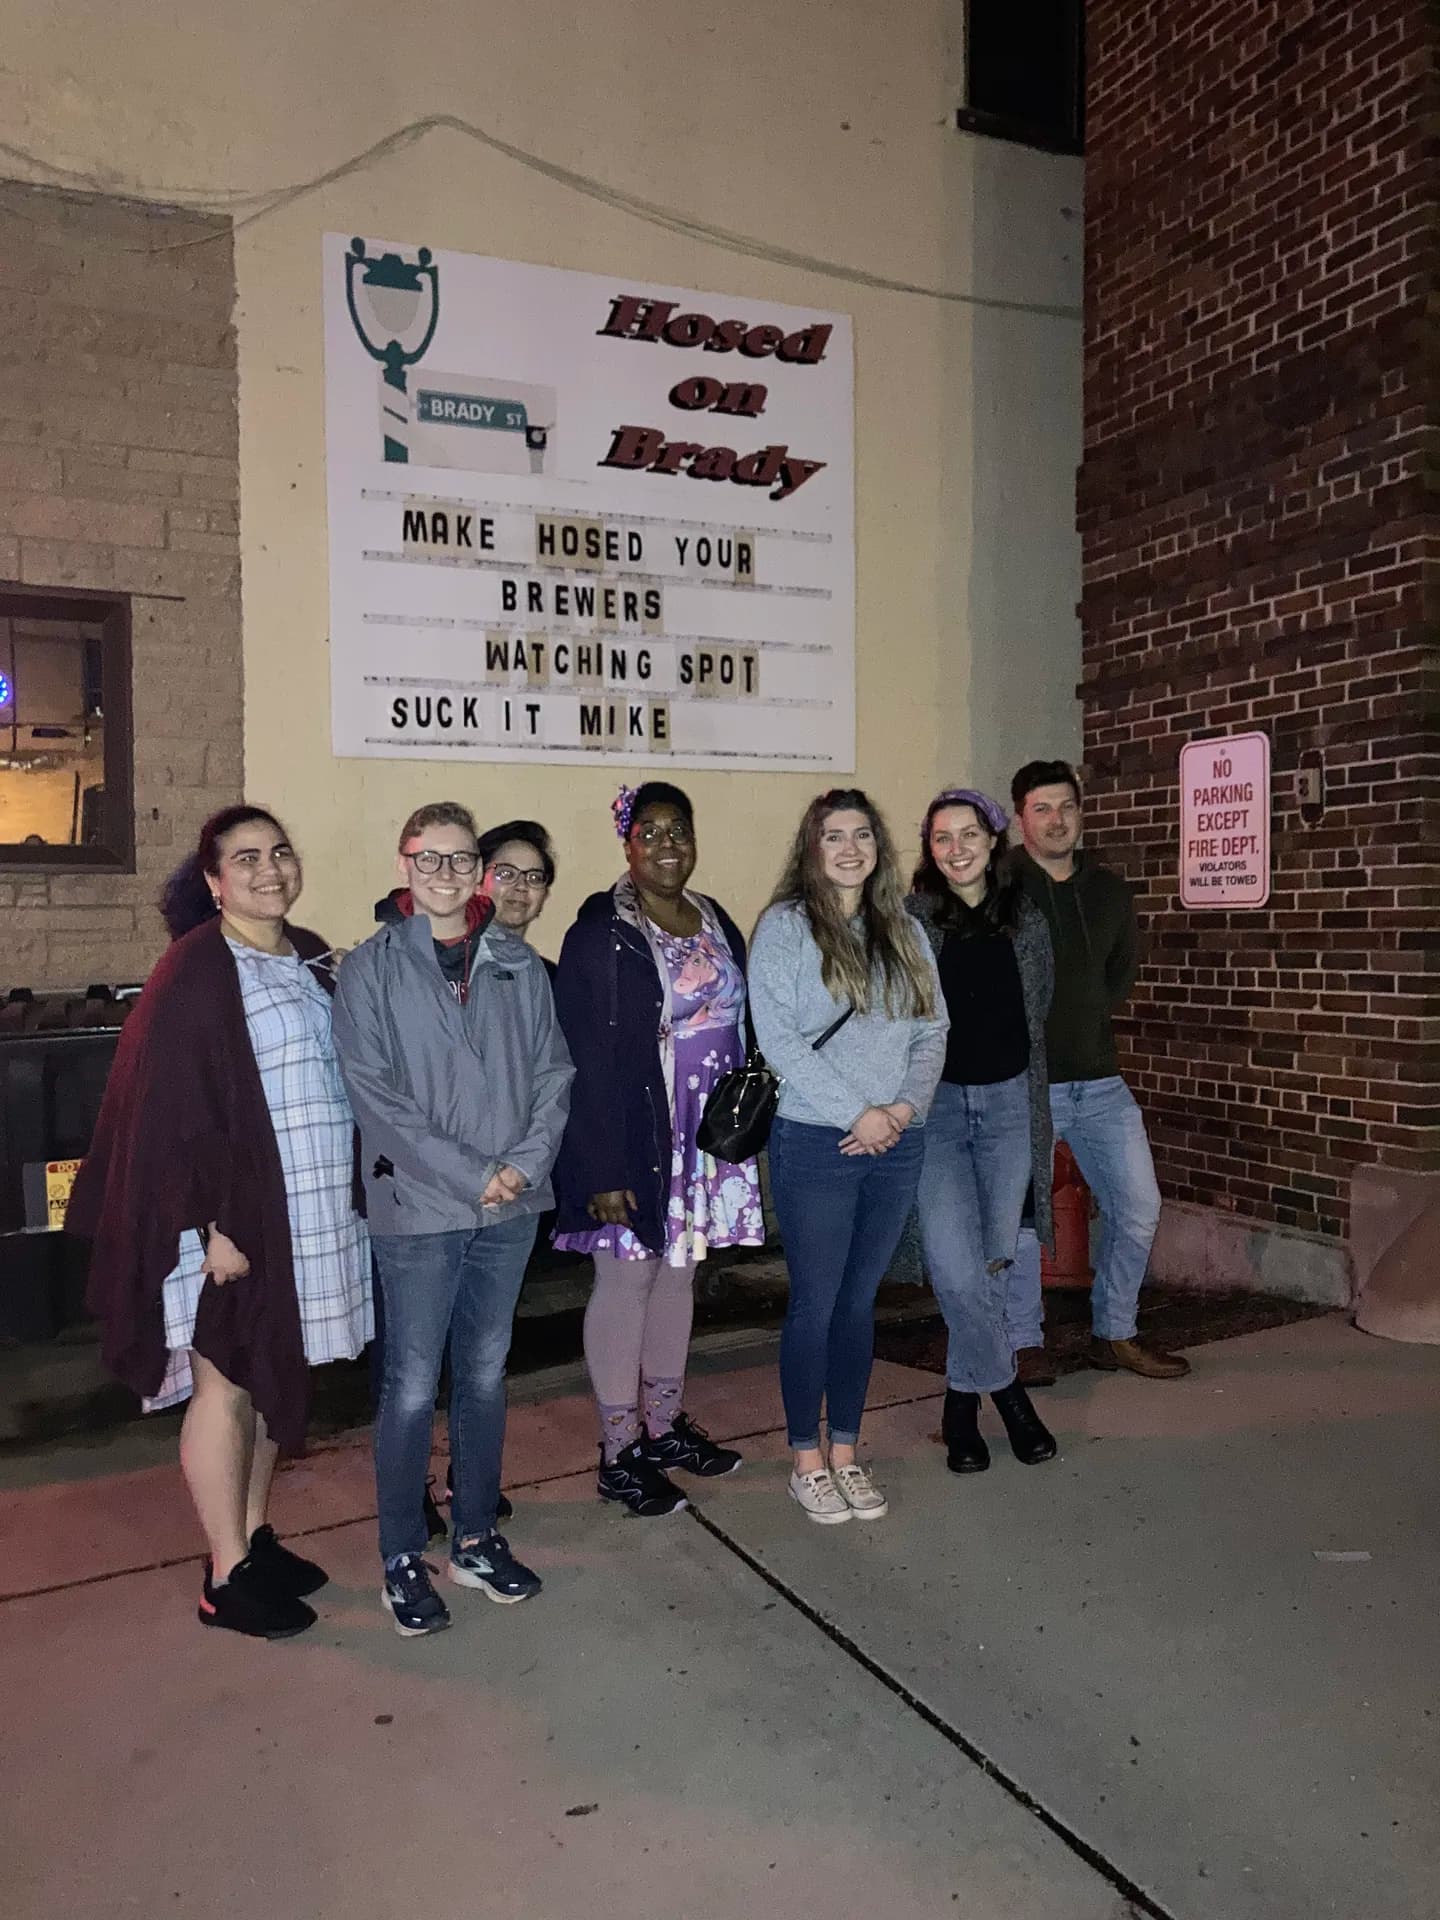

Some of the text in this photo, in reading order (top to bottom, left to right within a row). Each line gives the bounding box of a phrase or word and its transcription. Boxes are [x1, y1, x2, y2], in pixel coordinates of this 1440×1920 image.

[596, 294, 833, 364] Hosed
[431, 398, 523, 426] BRADY ST
[669, 376, 769, 417] on
[597, 424, 828, 501] Brady
[402, 509, 753, 575] MAKE HOSED YOUR
[502, 580, 662, 622] BREWERS
[486, 640, 755, 693] WATCHING SPOT
[391, 696, 668, 740] SUCK IT MIKE
[1212, 758, 1232, 779] NO
[1193, 782, 1253, 807] PARKING
[1197, 810, 1249, 832] EXCEPT
[1188, 835, 1260, 859] FIRE DEPT.
[1189, 874, 1258, 887] WILL BE TOWED
[1199, 860, 1247, 872] VIOLATORS
